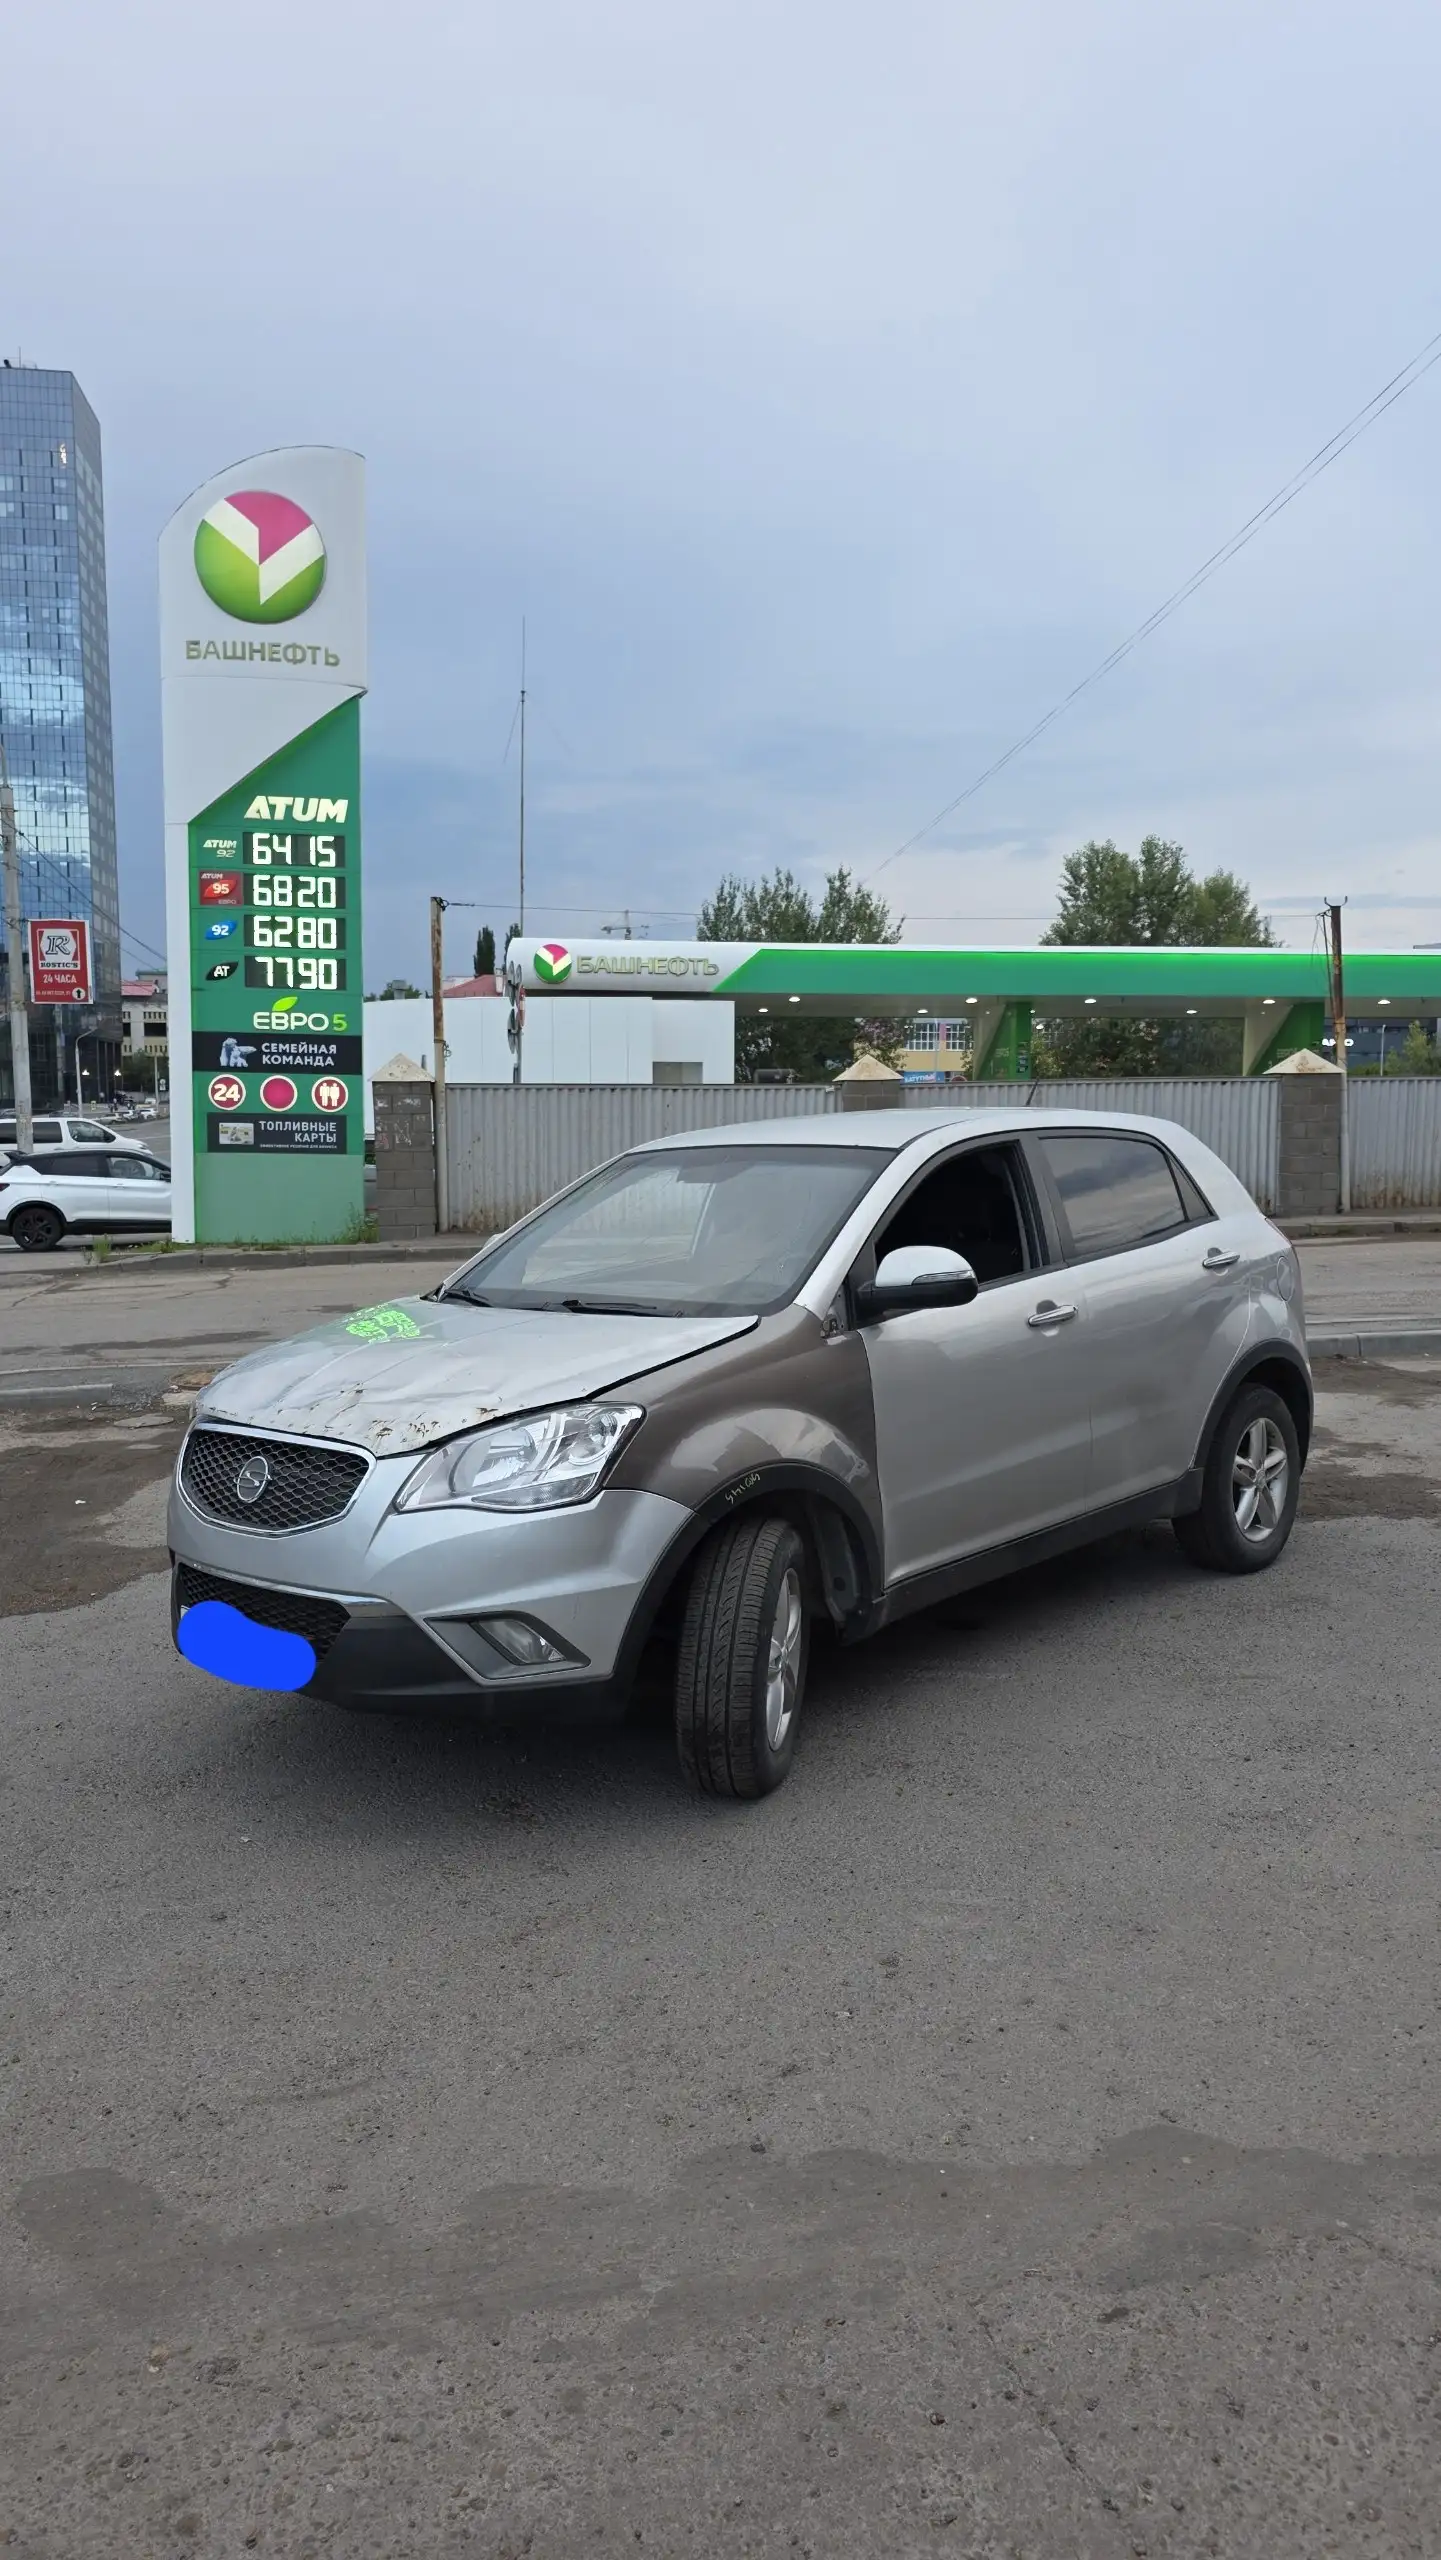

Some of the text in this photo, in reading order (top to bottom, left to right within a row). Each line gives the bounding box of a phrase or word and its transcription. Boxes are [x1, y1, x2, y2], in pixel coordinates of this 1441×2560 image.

[185, 639, 341, 668] БАШНЕФТЬ
[244, 795, 348, 823] ATUM
[203, 839, 237, 849] ATUM
[216, 849, 236, 858] 92
[201, 872, 224, 880] ATUM
[212, 883, 230, 895] 95
[211, 925, 229, 936] 92
[576, 955, 720, 977] БАШНЕФТЬ
[43, 974, 77, 984] 24 ЧАСА
[261, 1042, 337, 1054] СЕМЕЙНАЯ
[262, 1055, 335, 1067] КОМАНДА
[213, 1083, 241, 1102] 24
[259, 1120, 337, 1132] ТОПЛИВНЫЕ
[294, 1132, 337, 1143] КАРТЫ
